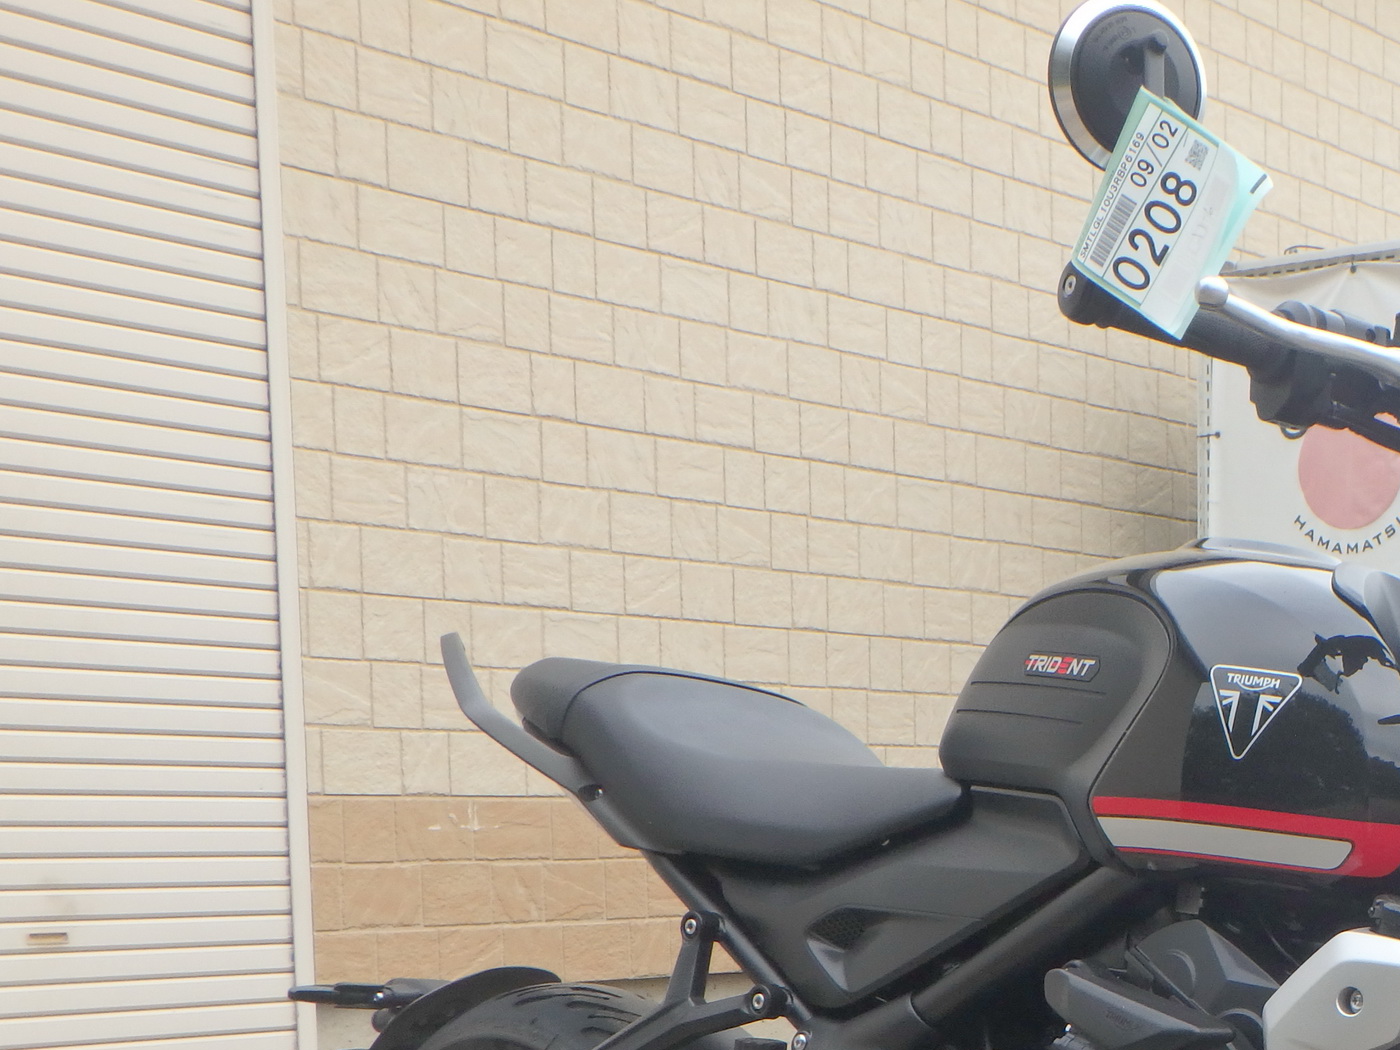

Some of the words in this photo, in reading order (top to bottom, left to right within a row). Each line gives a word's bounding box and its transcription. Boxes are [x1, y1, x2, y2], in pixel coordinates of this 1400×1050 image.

[1130, 120, 1179, 188] 09/02
[1112, 171, 1198, 291] 0208
[1025, 654, 1096, 676] TRIDENT
[1227, 672, 1281, 692] TRIUMPH
